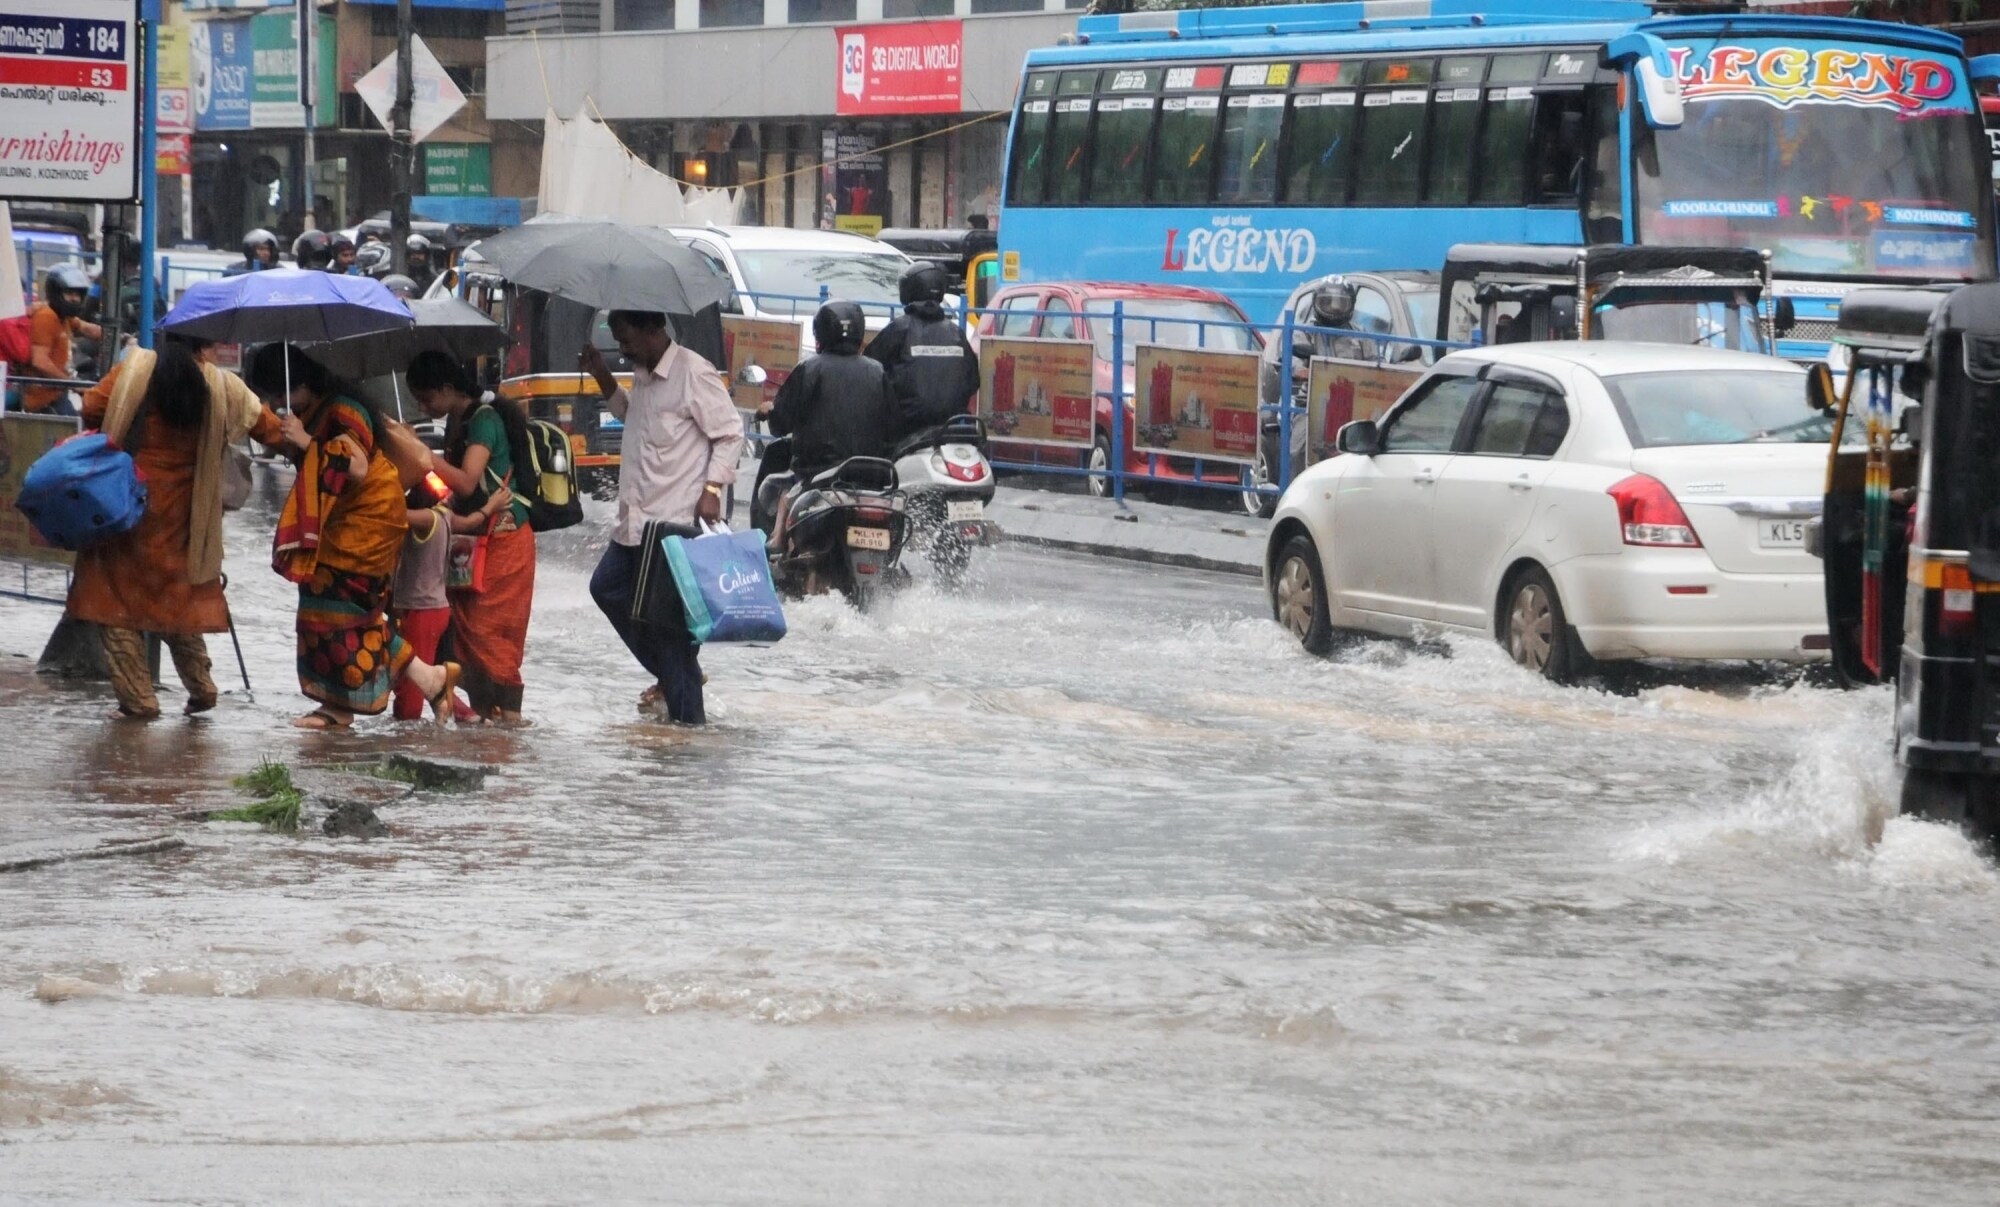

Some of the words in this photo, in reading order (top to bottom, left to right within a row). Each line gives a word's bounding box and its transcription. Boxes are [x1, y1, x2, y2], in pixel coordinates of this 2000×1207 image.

[88, 26, 119, 52] 184
[844, 45, 863, 75] 3G
[872, 46, 887, 72] 3G
[888, 46, 922, 71] DIGITAL
[923, 44, 959, 70] WORLD
[90, 68, 112, 87] 53
[1670, 45, 1954, 108] LEGEND
[160, 95, 185, 111] 3G
[427, 149, 469, 158] PASSPORT
[38, 168, 89, 180] KOZHIKODE
[428, 166, 457, 176] PHOTO
[1670, 201, 1770, 216] KOORACHUNDU
[1895, 210, 1963, 224] KOZHIKODE
[1162, 227, 1317, 273] LEGEND
